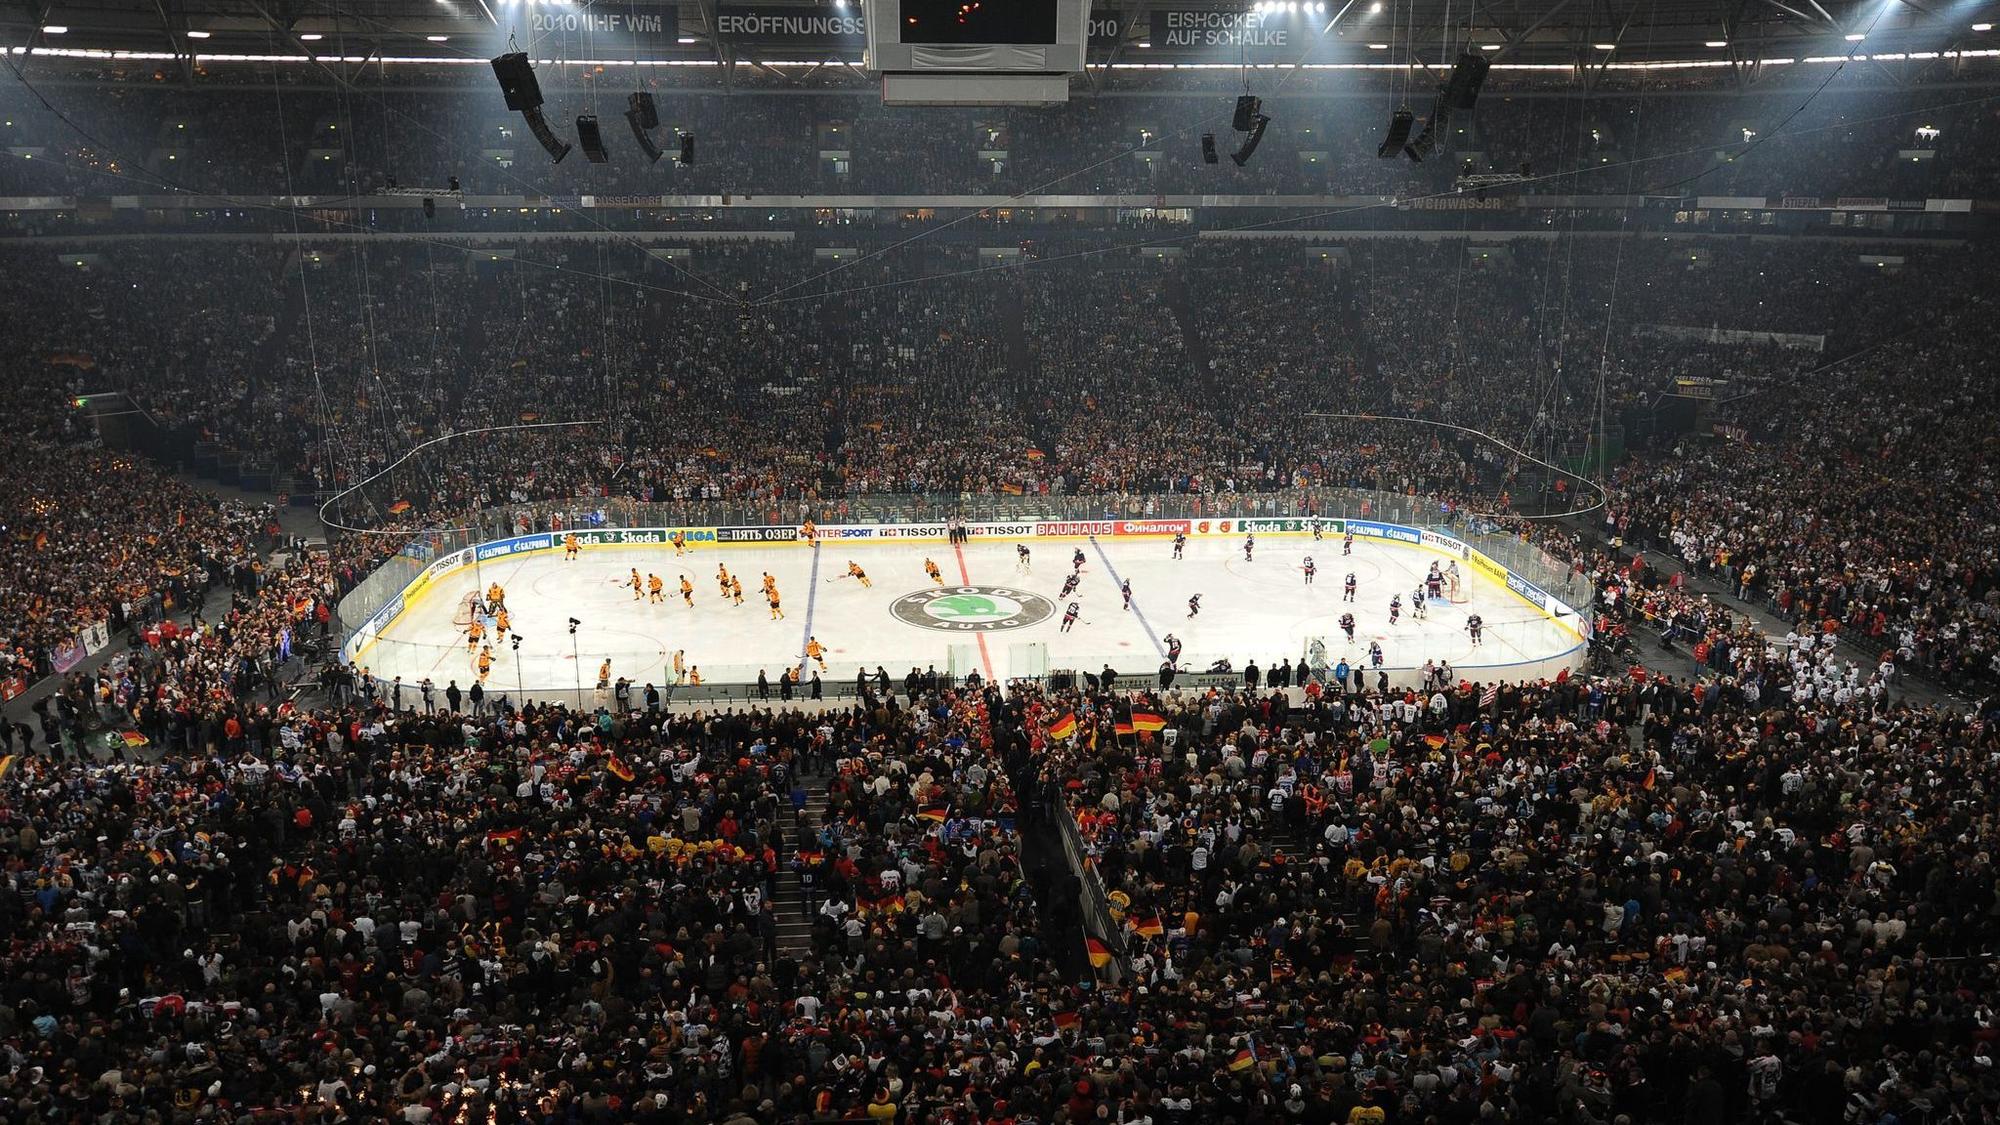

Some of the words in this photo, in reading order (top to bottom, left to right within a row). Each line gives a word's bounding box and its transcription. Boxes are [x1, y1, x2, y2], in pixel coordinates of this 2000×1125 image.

[533, 14, 577, 32] 2010
[625, 14, 662, 33] WM
[1166, 12, 1267, 28] EISHOCKEY
[1165, 30, 1201, 46] AUF
[1205, 30, 1288, 46] SCHALKE
[899, 527, 946, 537] TISSOT
[985, 525, 1032, 535] TISSOT
[1036, 522, 1112, 536] BAUHAUS
[1244, 519, 1281, 533] Škoda
[1300, 518, 1339, 533] Škda
[620, 529, 660, 543] Škoda
[731, 529, 763, 541] ПЯТЬ
[765, 528, 796, 540] ОЗЕР
[812, 528, 873, 538] NTERSPORT
[1435, 535, 1462, 551] TISSOT
[435, 554, 460, 572] TISSOT
[932, 620, 1020, 630] AUTO
